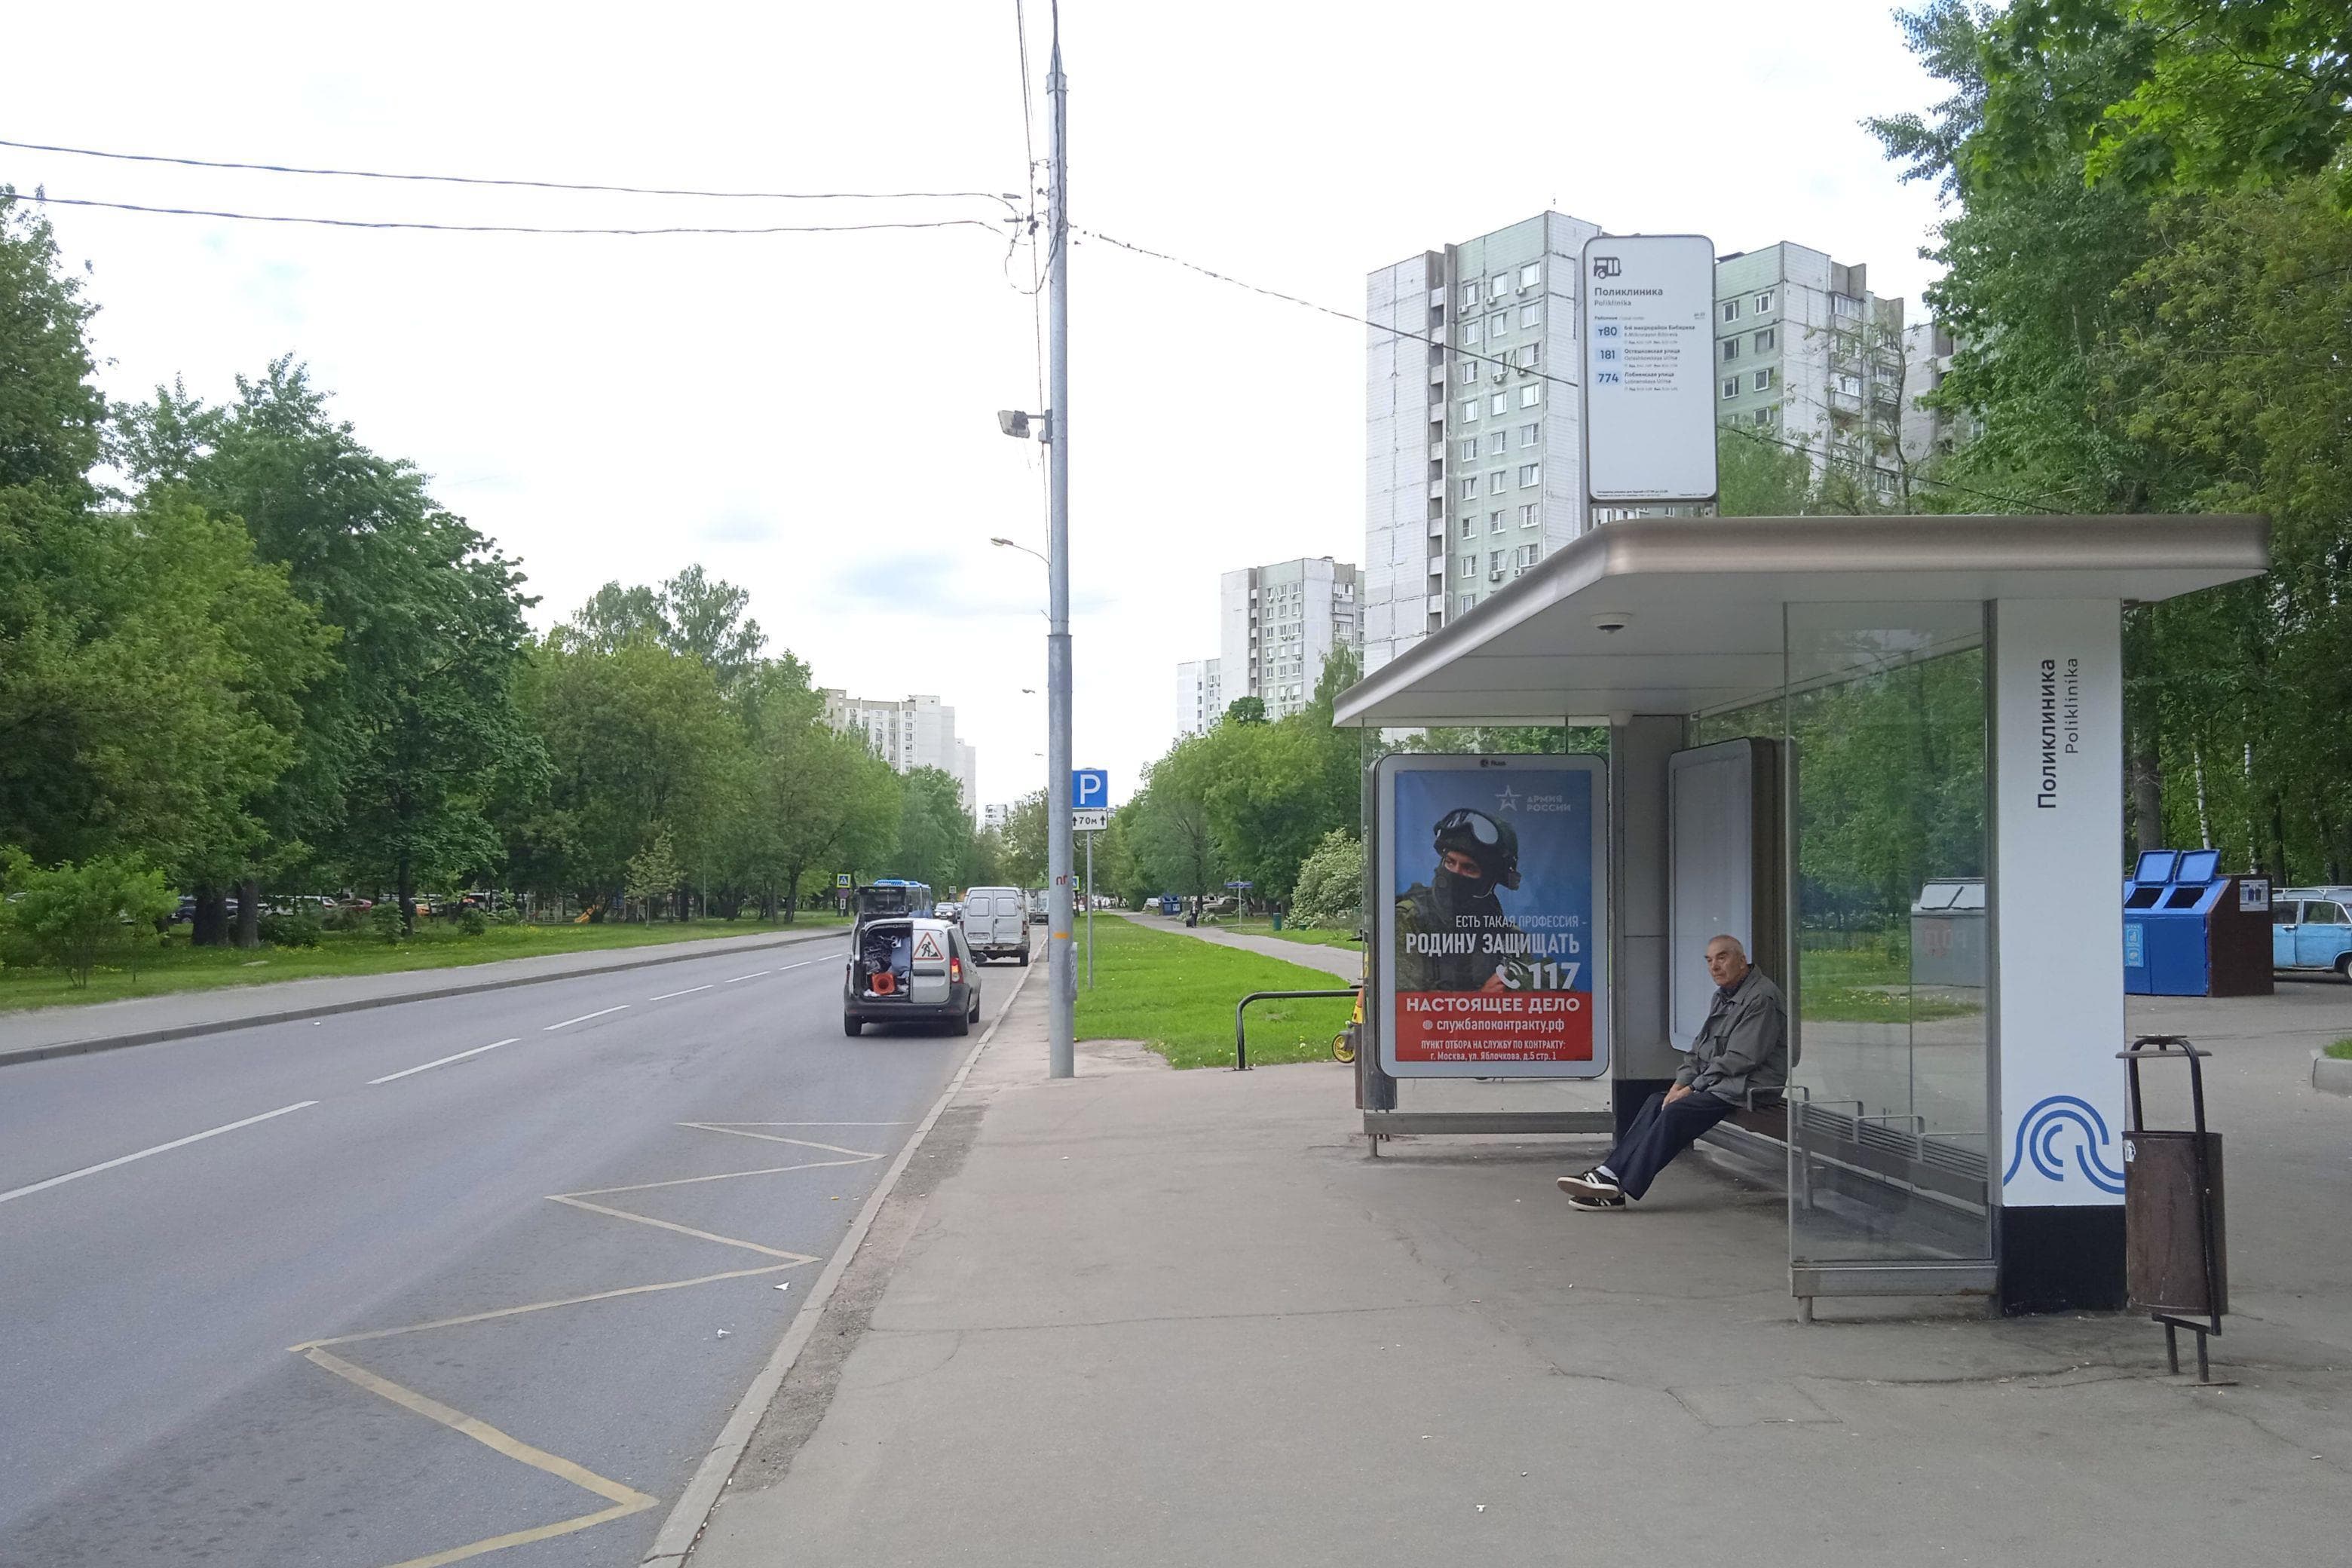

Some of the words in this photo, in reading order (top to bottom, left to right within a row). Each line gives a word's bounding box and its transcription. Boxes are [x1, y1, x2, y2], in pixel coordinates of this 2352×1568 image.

[1594, 287, 1663, 296] Поликлиника
[1600, 350, 1615, 360] 181
[1598, 373, 1619, 383] 774
[2064, 658, 2078, 754] Poliklinika
[2038, 659, 2056, 808] Поликлиника
[1080, 774, 1101, 805] P
[1527, 804, 1572, 812] РОССИИ
[1456, 915, 1481, 928] ЕСТЬ
[1483, 915, 1515, 928] ТАКАЯ
[1518, 915, 1579, 928] ПРОФЕССИЯ
[1405, 933, 1476, 957] РОДИНУ
[1482, 933, 1580, 957] ЗАЩИЩАТЬ
[1527, 962, 1581, 990] 117
[1406, 997, 1523, 1014] НАСТОЯЩЕЕ
[1528, 997, 1580, 1014] ДЕЛО
[1437, 1017, 1565, 1034] службапоконтракту.рф
[1421, 1040, 1444, 1049] ПУНКТ
[1445, 1040, 1472, 1049] ОТБОРА
[1473, 1040, 1482, 1049] НА
[1483, 1040, 1512, 1049] СЛУЖБУ
[1513, 1040, 1523, 1049] ПО
[1524, 1040, 1566, 1049] КОНТРАКТУ:
[1438, 1052, 1468, 1061] Москва,
[1468, 1053, 1478, 1061] ул.
[1480, 1052, 1522, 1061] Яблочкова,
[1536, 1053, 1551, 1061] стр.
[1552, 1052, 1557, 1060] 1
